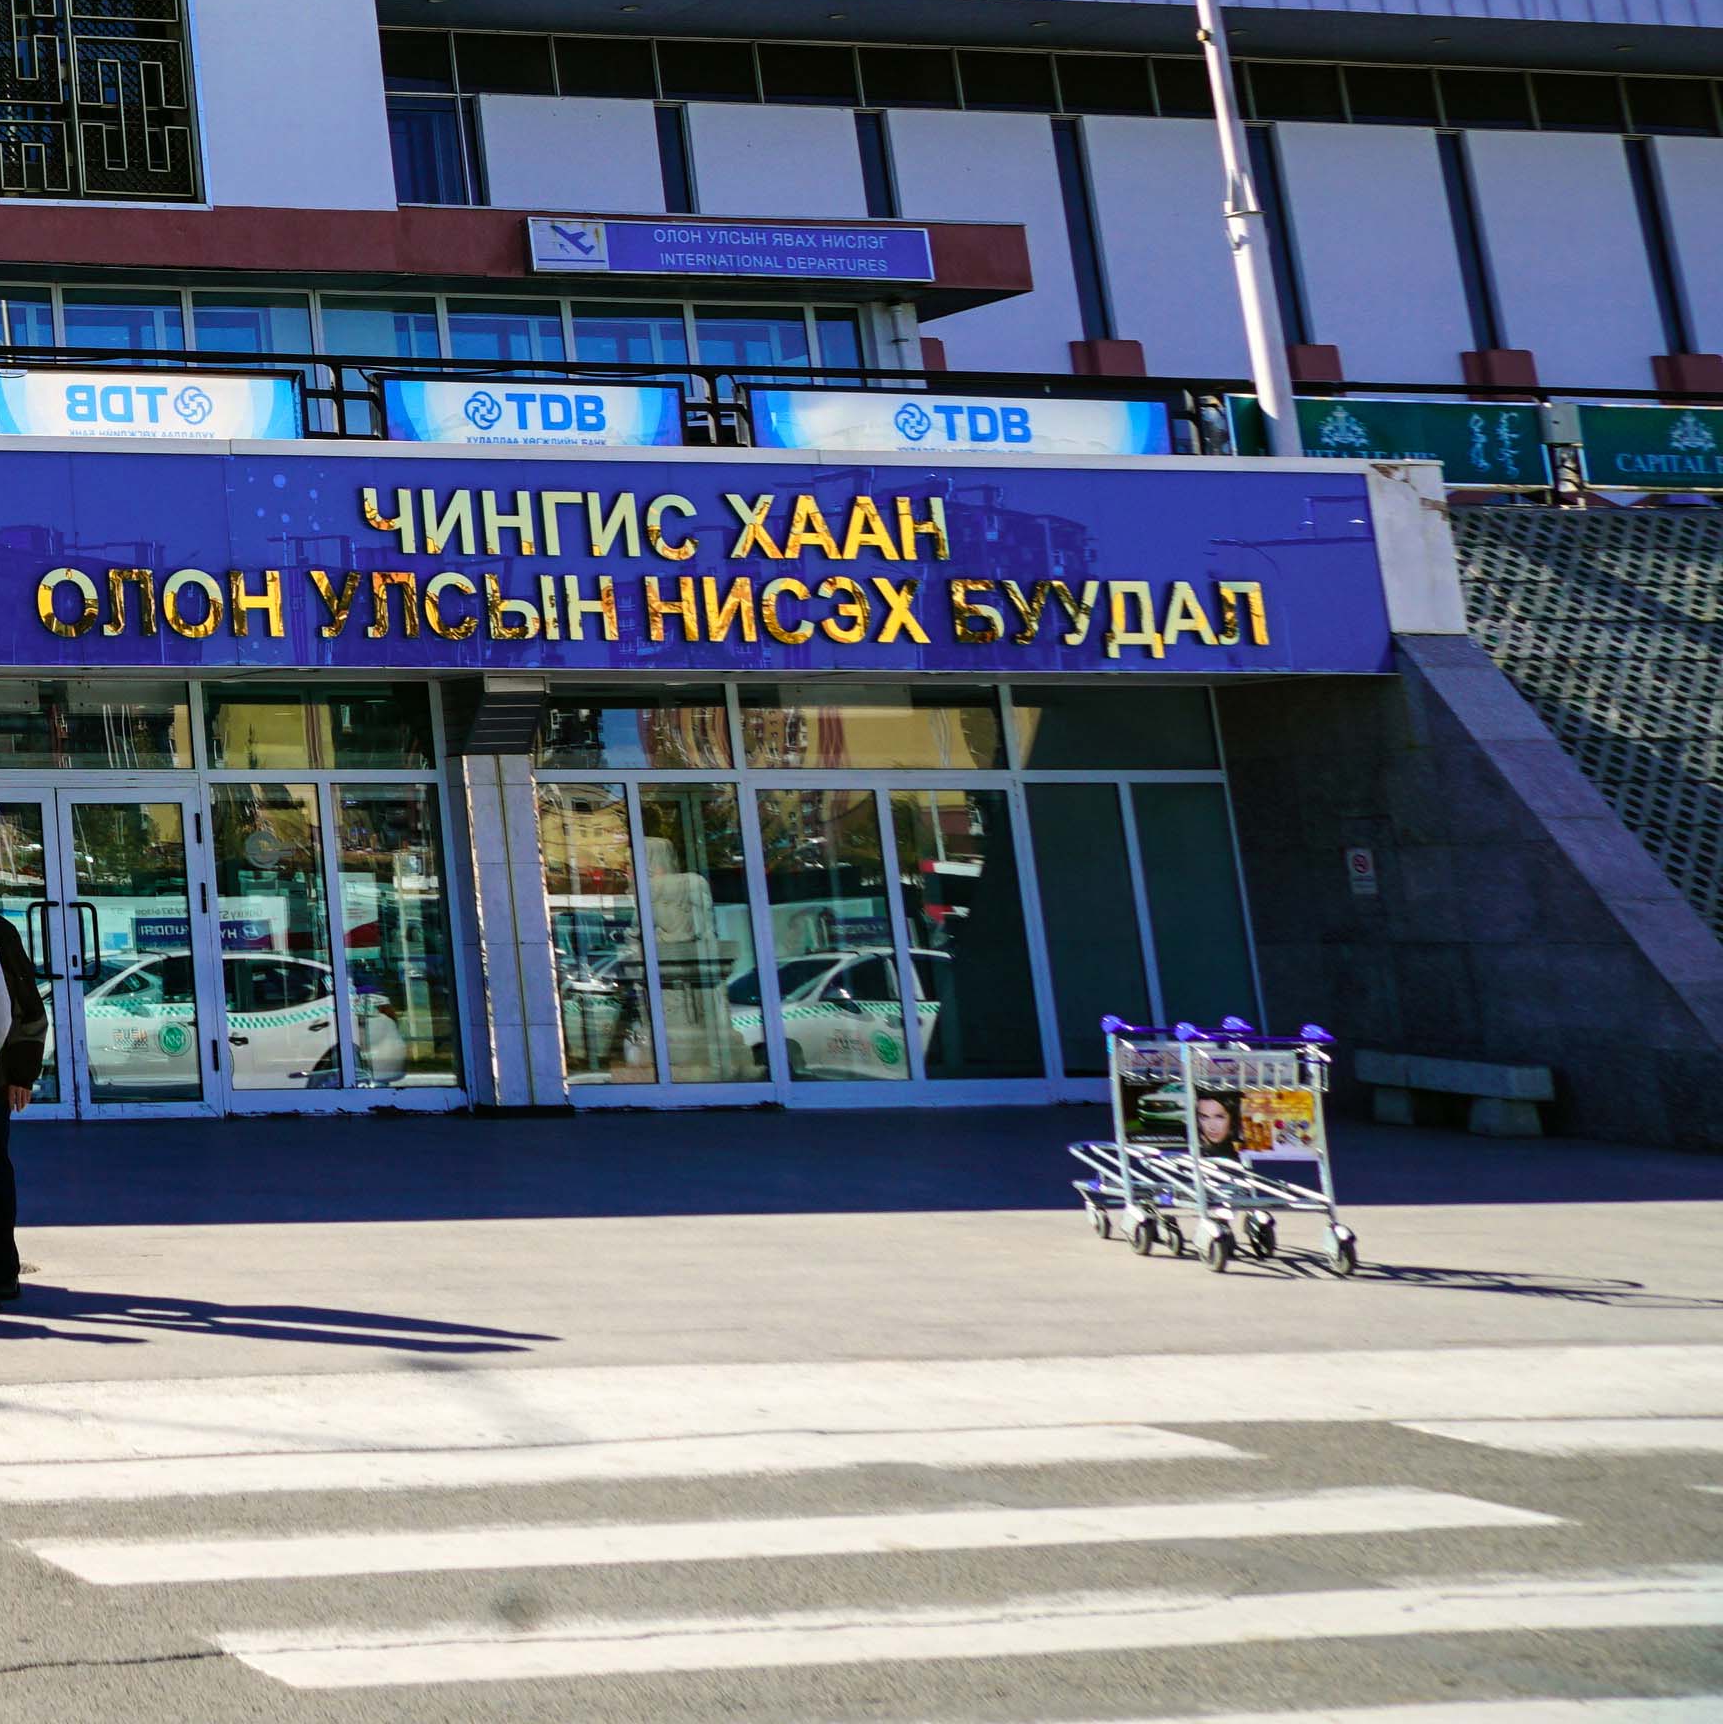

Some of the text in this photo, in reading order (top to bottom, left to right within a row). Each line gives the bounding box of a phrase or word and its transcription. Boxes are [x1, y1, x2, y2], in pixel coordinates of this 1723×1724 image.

[654, 229, 888, 250] ОЛОН УЛСЫН ЯВАХ НИСЛЭГ
[660, 252, 888, 272] INTERNATIONAL DEPARTURES
[505, 393, 606, 431] TDB
[933, 405, 1032, 443] TDB
[1616, 452, 1714, 474] CAPITAL
[363, 487, 951, 562] ЧИНГИС ХААН
[36, 567, 1270, 659] ОЛОН УЛСЫН НИСЭХ БУУДАЛ
